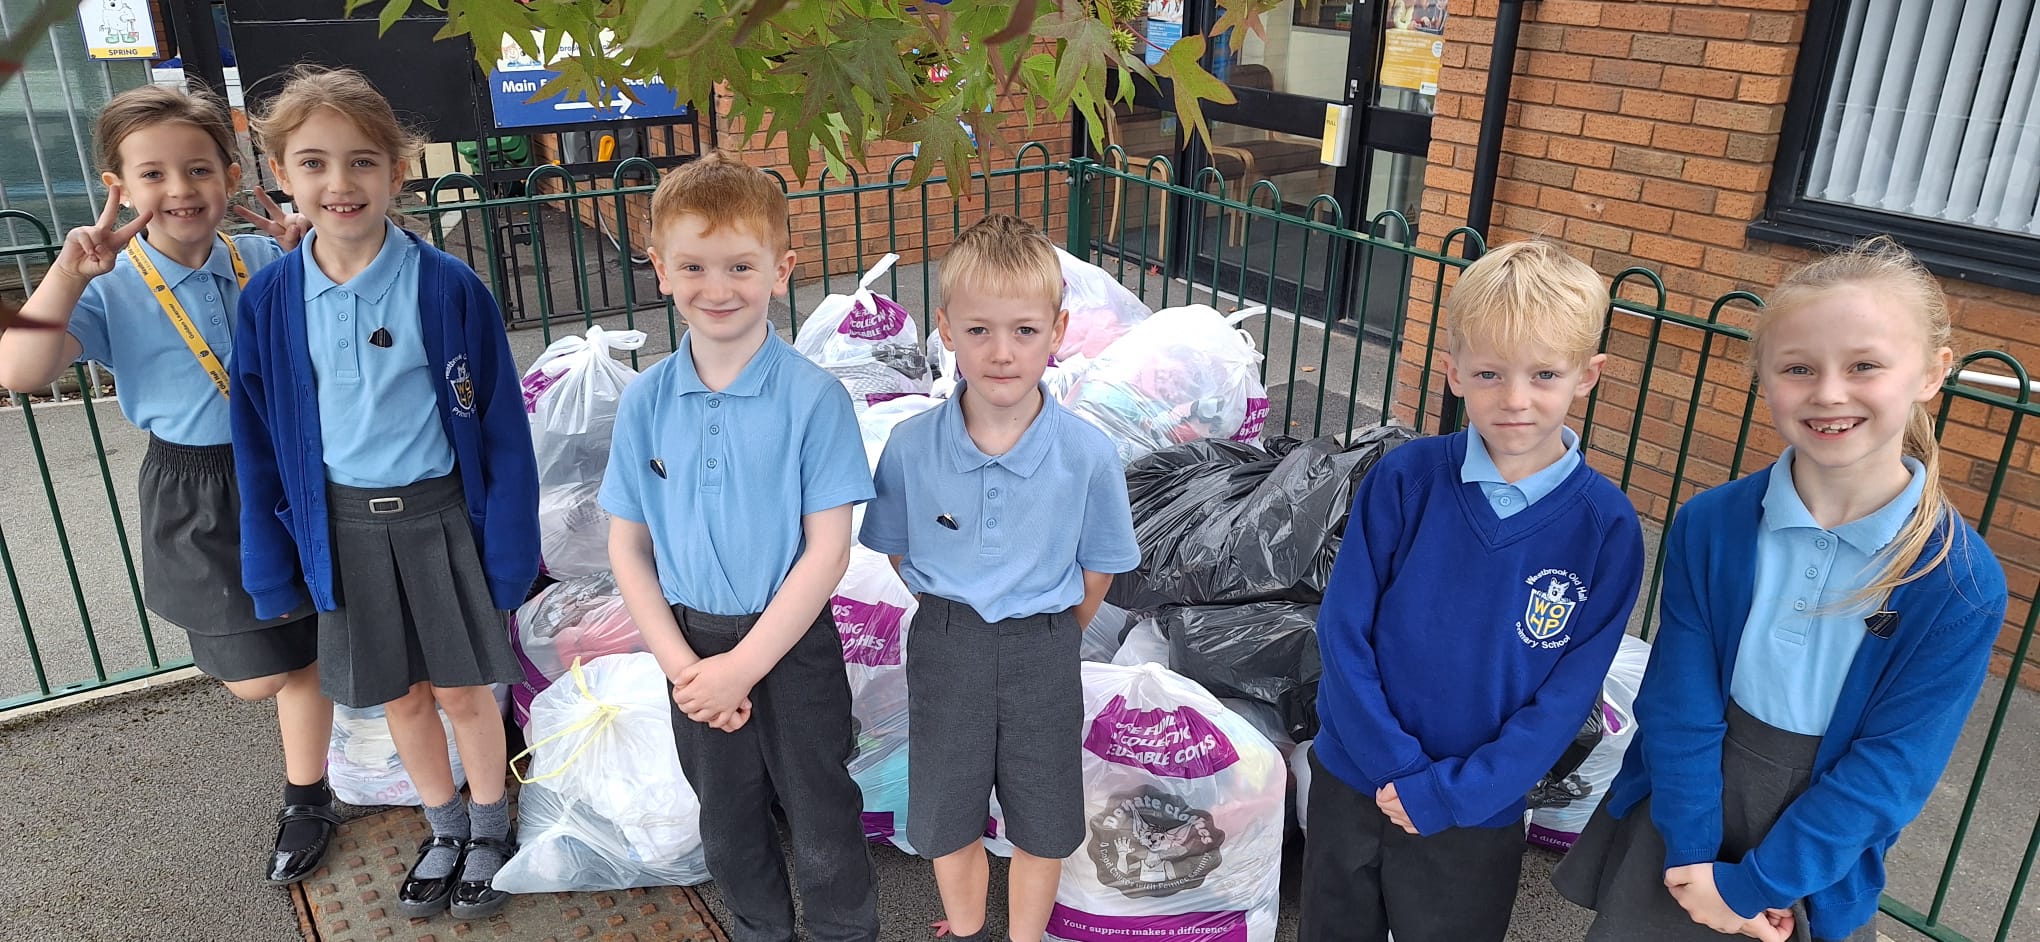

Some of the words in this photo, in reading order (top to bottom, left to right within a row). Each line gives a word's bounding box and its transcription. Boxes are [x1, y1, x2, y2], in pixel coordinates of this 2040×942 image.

[108, 48, 138, 56] SPRING
[502, 79, 536, 93] Main
[1525, 568, 1568, 586] Westbrook
[1568, 572, 1582, 586] Old
[1576, 587, 1588, 602] Hall
[1516, 621, 1539, 648] Primary
[1542, 634, 1570, 648] School
[1102, 795, 1162, 829] Donate
[1540, 835, 1573, 848] differe
[1062, 918, 1087, 930] Your
[1089, 926, 1130, 936] support
[1132, 927, 1166, 936] makes
